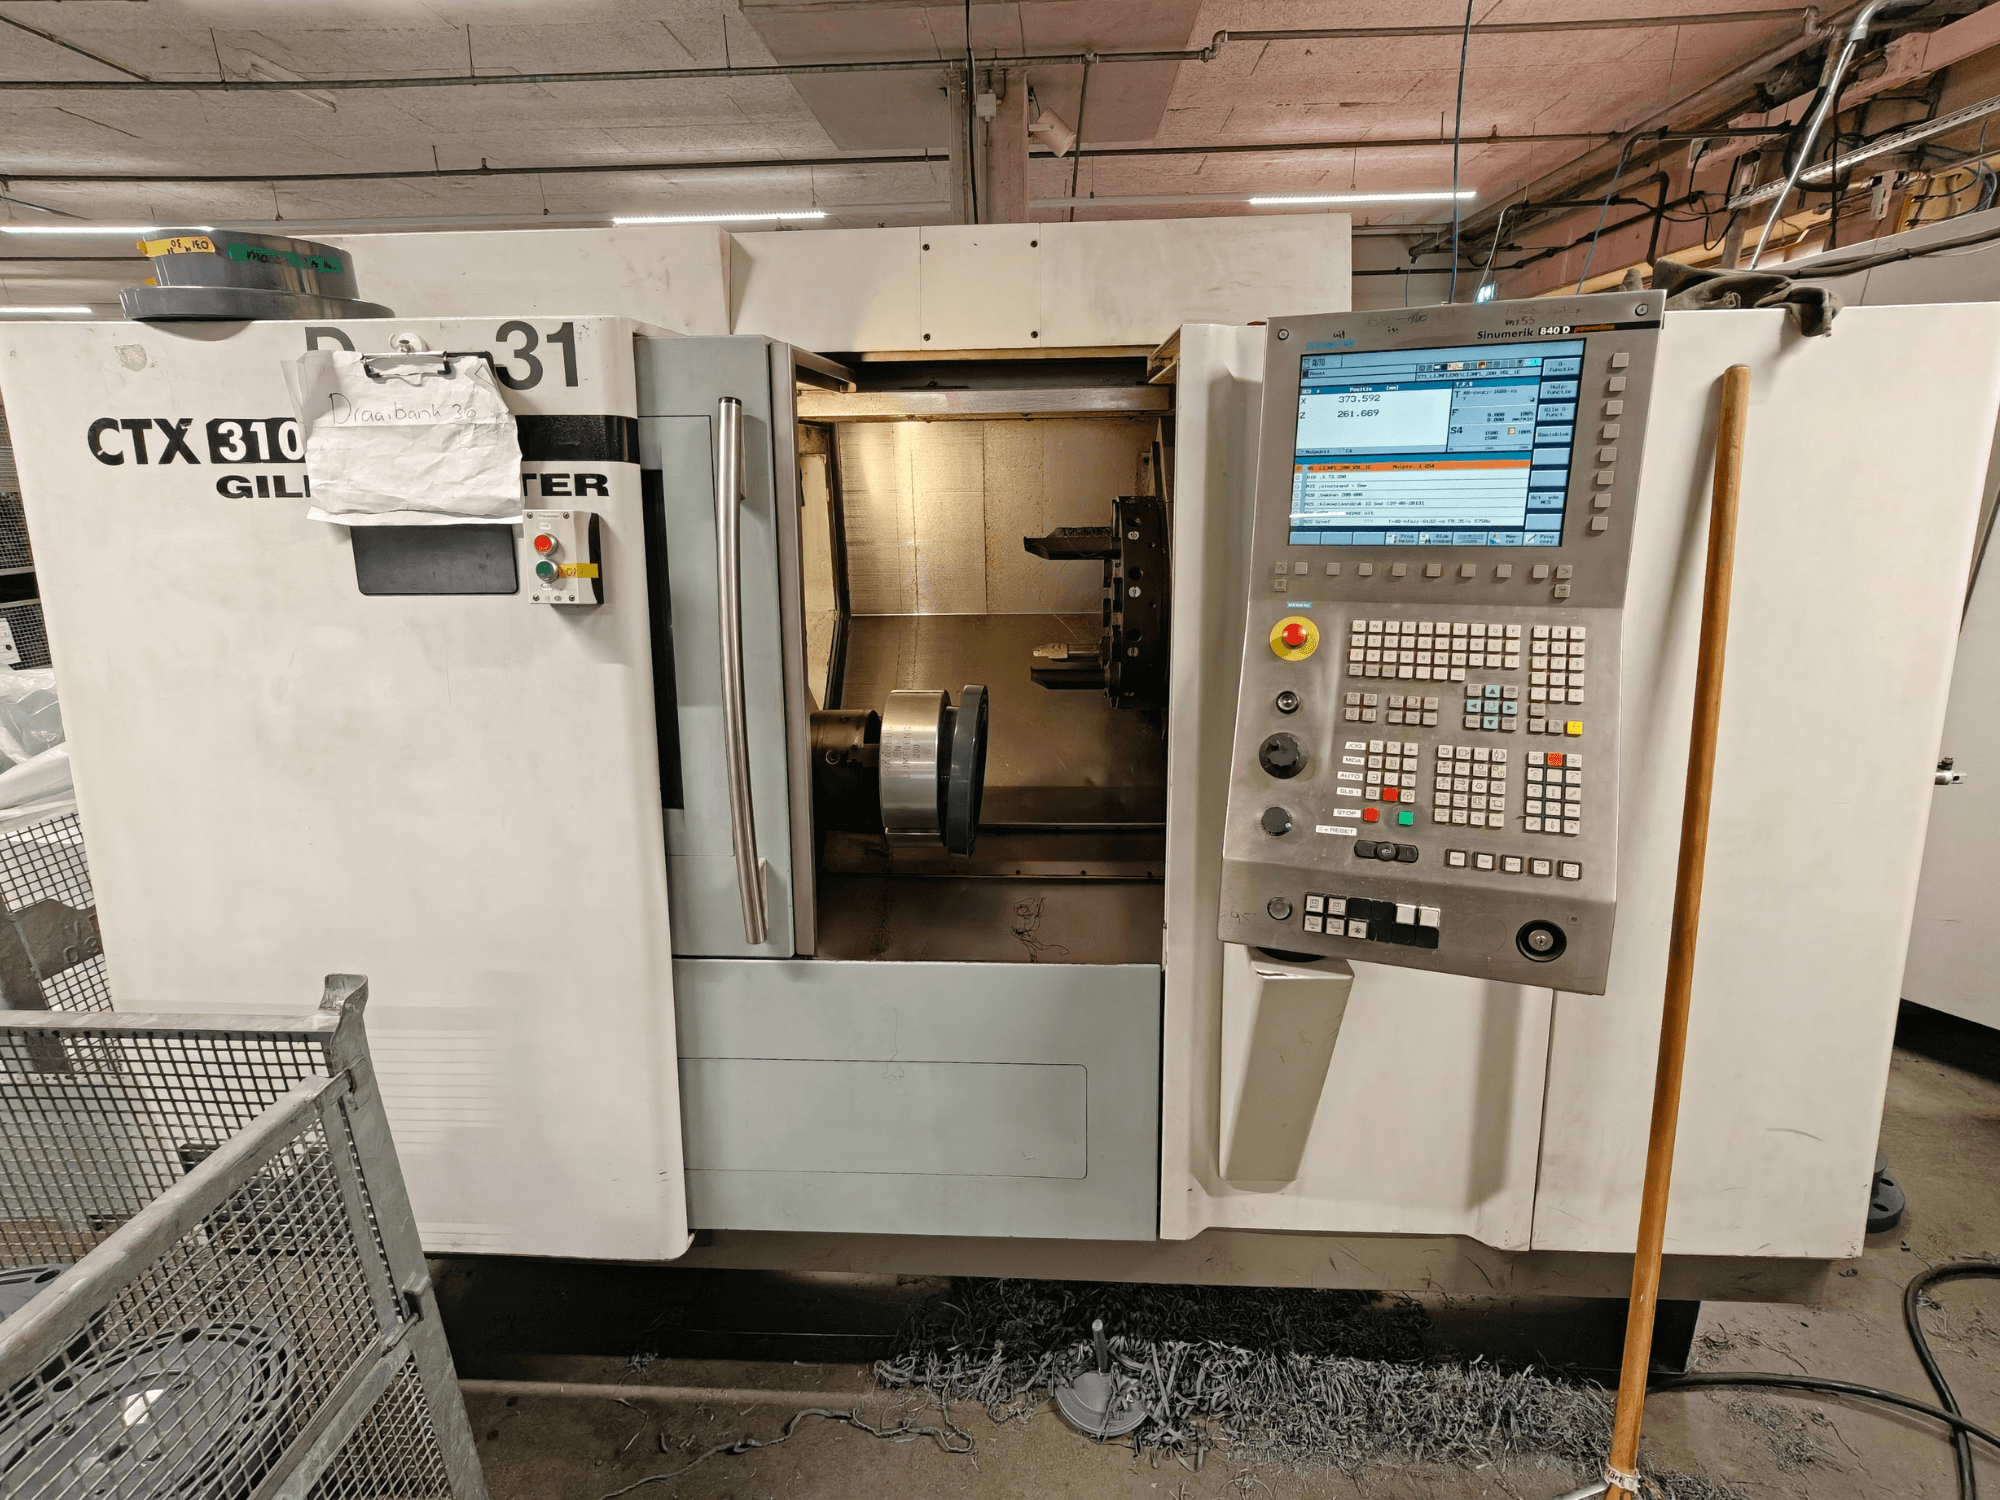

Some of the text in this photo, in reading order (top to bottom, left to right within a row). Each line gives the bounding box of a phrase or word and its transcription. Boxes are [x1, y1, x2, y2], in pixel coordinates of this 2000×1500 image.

[1477, 323, 1616, 340] Sinumerik 840 D powerline
[495, 320, 579, 391] 31
[1338, 394, 1381, 403] 373.592
[1454, 390, 1460, 398] T
[329, 392, 477, 425] Draaibank 30
[1337, 409, 1380, 418] 261.669
[1452, 408, 1459, 416] F
[1450, 426, 1463, 434] S4
[87, 417, 305, 466] CTX 310
[894, 745, 901, 758] EN
[912, 744, 921, 759] 200
